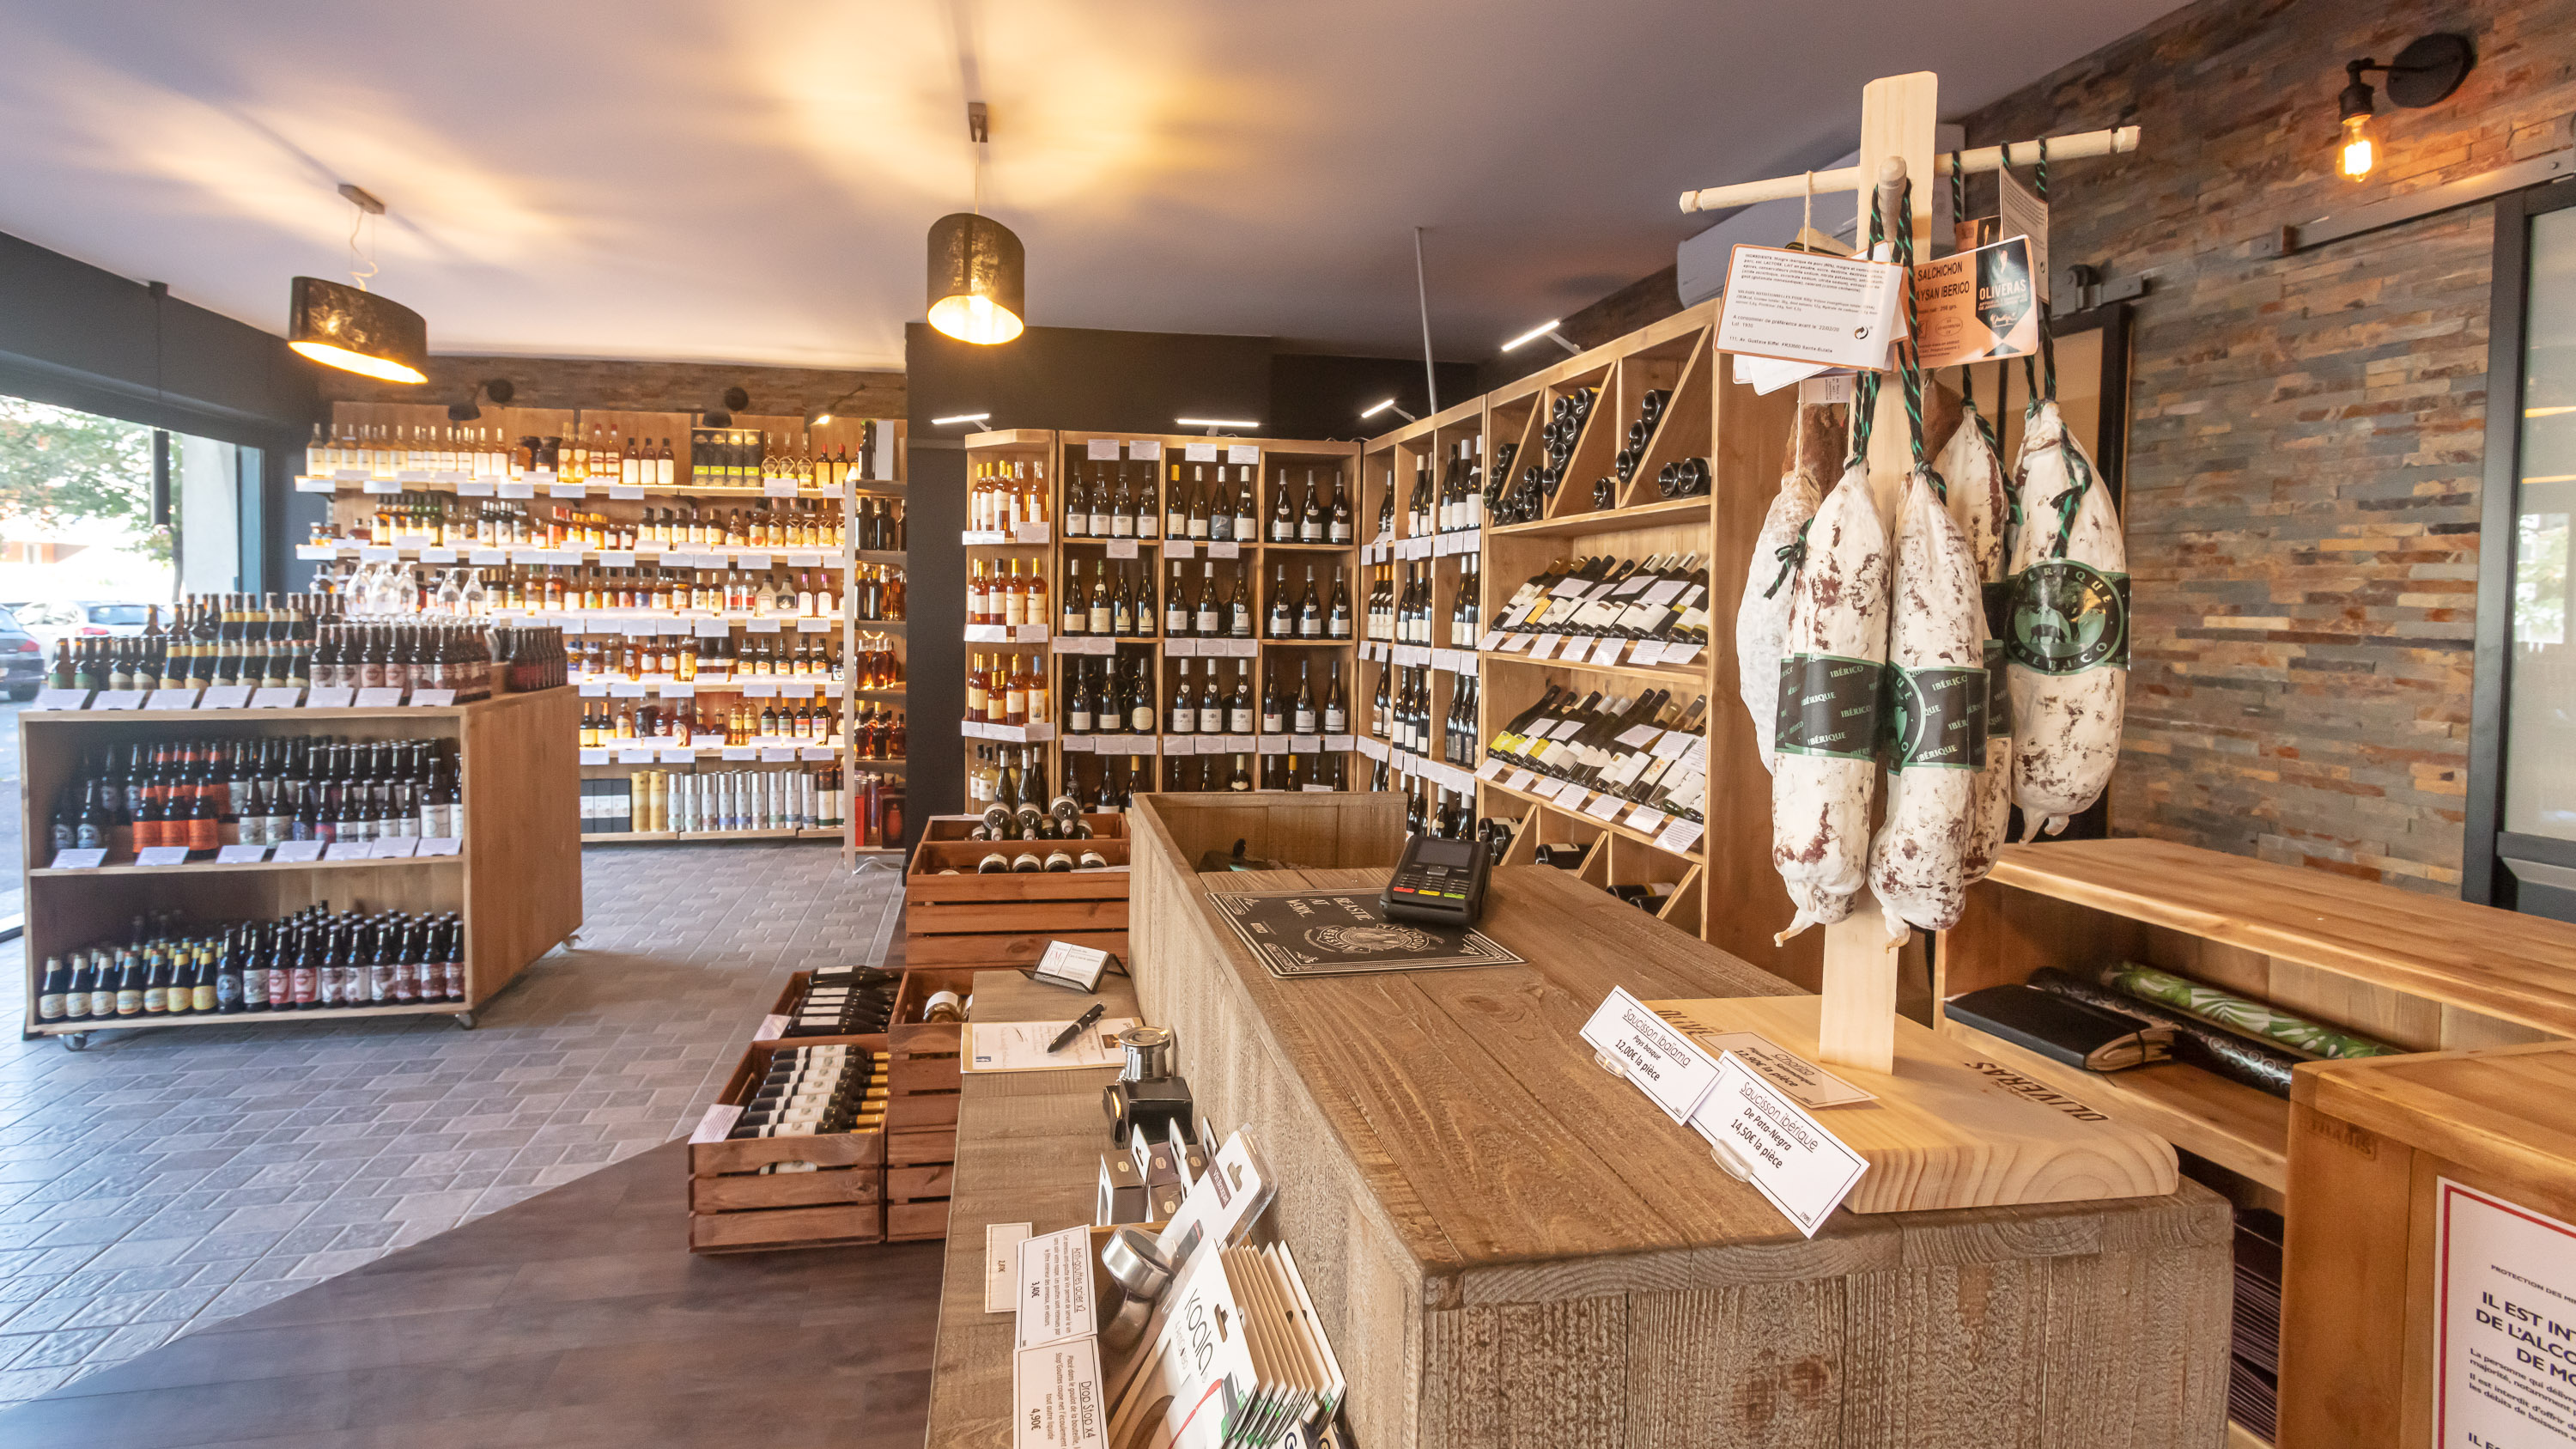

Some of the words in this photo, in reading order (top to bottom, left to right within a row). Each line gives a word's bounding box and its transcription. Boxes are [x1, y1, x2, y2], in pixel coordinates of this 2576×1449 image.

[1917, 261, 1963, 282] SALCHICHON
[1915, 287, 1940, 301] AYSAN
[1941, 281, 1970, 298] IBERICO
[1979, 279, 2026, 301] OLIVERAS
[1830, 665, 1864, 678] IBÉRICO
[1931, 675, 1968, 691] IBÉRICO
[1801, 691, 1836, 706] IBÉRIQUE
[1841, 705, 1871, 718] IBÉRICO
[1807, 732, 1846, 746] IBÉRIQUE
[1916, 745, 1958, 763] IBÉRIQUE
[1333, 898, 1375, 921] BEASTIE
[1622, 1008, 1660, 1041] Saucisson
[1655, 1033, 1693, 1067] Ibaïama
[1631, 1034, 1646, 1048] Pays
[1642, 1043, 1662, 1061] basque
[1613, 1038, 1638, 1061] 12,00€
[1633, 1054, 1645, 1067] la
[1639, 1060, 1662, 1082] pièce
[1772, 1053, 1815, 1076] Chorizo
[1771, 1072, 1798, 1087] pièce
[1965, 1062, 2109, 1122] OLIVERAS
[1739, 1081, 1783, 1120] Saucisson
[1777, 1112, 1820, 1153] ibérique
[1742, 1106, 1756, 1120] De
[1750, 1114, 1793, 1153] Pata-Negra
[1728, 1117, 1758, 1145] 14,50€
[1752, 1138, 1765, 1151] la
[1759, 1145, 1785, 1170] pièce
[1072, 1247, 1084, 1285] Anti-gouttes
[1030, 1281, 1040, 1298] 3,40€
[2491, 1264, 2544, 1291] PROTECTION
[2546, 1288, 2562, 1299] DES
[1074, 1286, 1084, 1303] acier
[1075, 1304, 1085, 1312] x2
[2483, 1291, 2500, 1310] IL
[2505, 1300, 2543, 1327] EST
[2476, 1308, 2503, 1332] DE
[1066, 1355, 1074, 1368] Placé
[2470, 1348, 2482, 1358] La
[2484, 1356, 2526, 1380] personne
[2529, 1378, 2544, 1388] qui
[2517, 1348, 2544, 1372] DE
[1066, 1368, 1075, 1381] dans
[2470, 1359, 2512, 1385] majorité,
[2513, 1380, 2571, 1412] notamment
[1055, 1385, 1064, 1400] coupe
[1067, 1387, 1077, 1404] goulot
[1079, 1380, 1093, 1403] Drop
[2478, 1379, 2492, 1389] est
[2494, 1385, 2530, 1408] interdit
[2532, 1405, 2565, 1424] d'offrir
[1029, 1408, 1042, 1430] 4,90€
[1045, 1405, 1054, 1420] autre
[1081, 1403, 1096, 1426] Stop
[2470, 1382, 2482, 1393] les
[2484, 1391, 2512, 1409] débits
[2514, 1406, 2526, 1416] de
[2528, 1411, 2568, 1438] boissons
[1045, 1421, 1055, 1440] liquide
[1069, 1419, 1080, 1446] bouteille,
[1084, 1427, 1097, 1439] x4
[2468, 1432, 2482, 1447] IL
